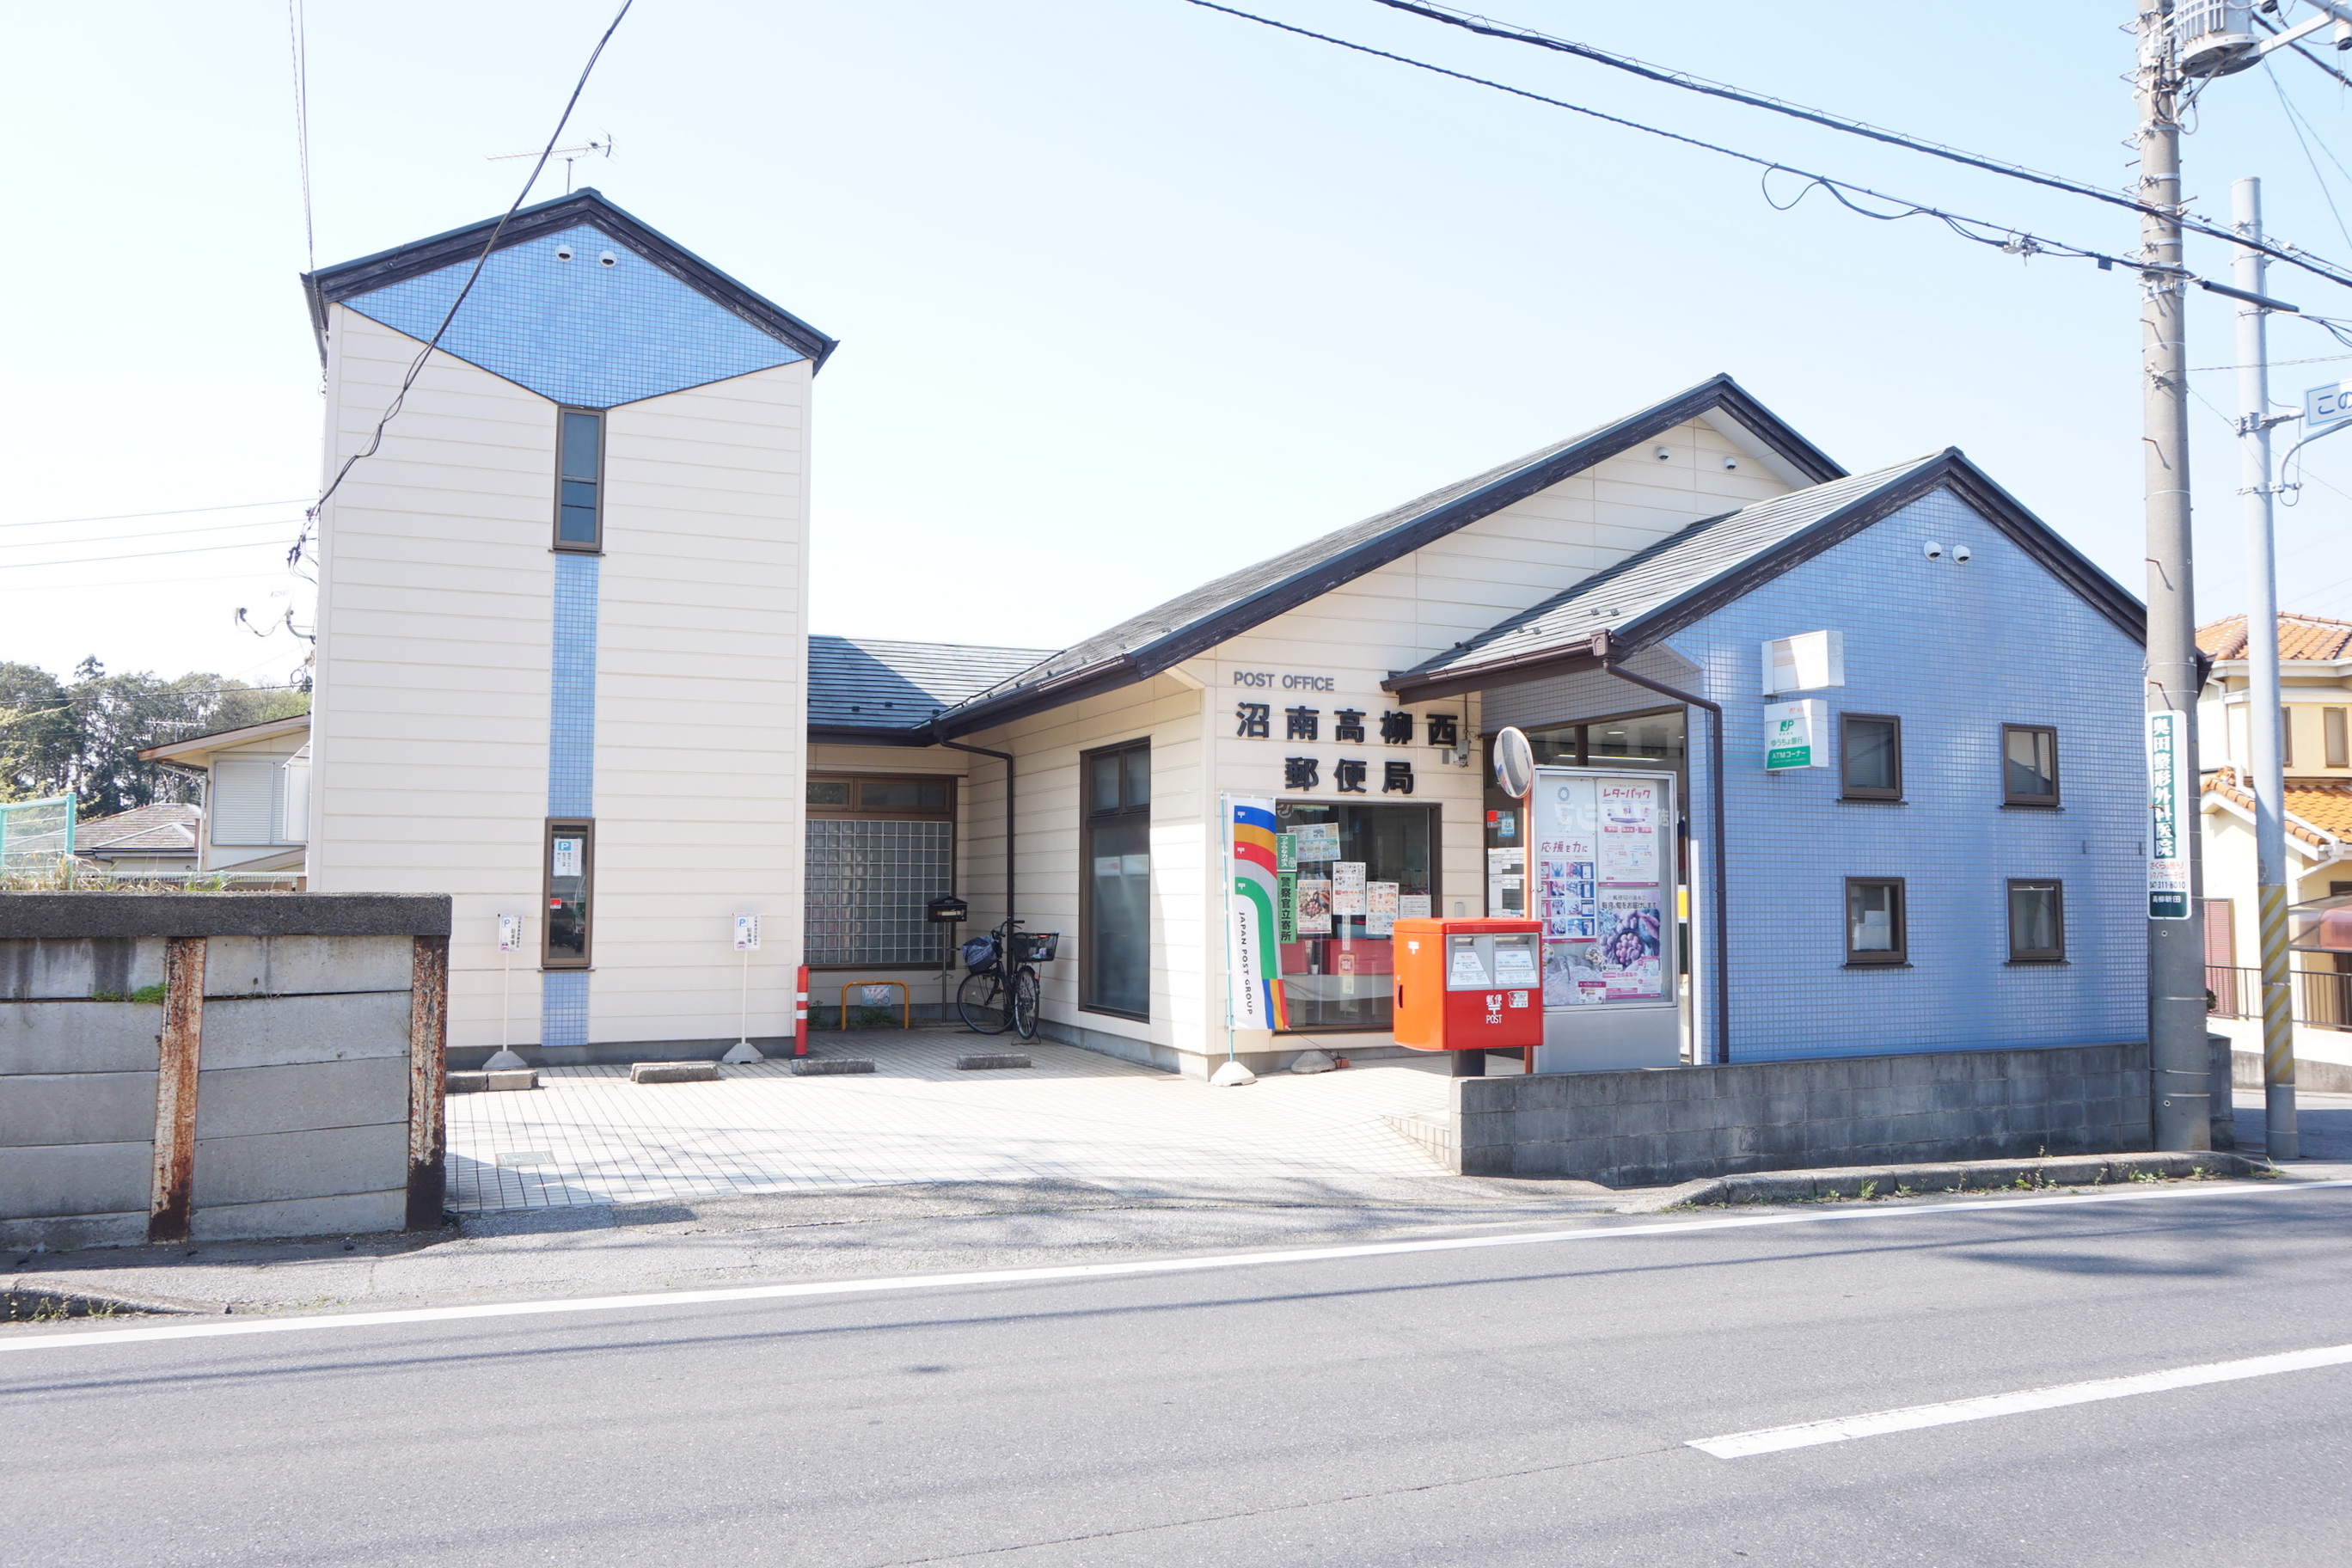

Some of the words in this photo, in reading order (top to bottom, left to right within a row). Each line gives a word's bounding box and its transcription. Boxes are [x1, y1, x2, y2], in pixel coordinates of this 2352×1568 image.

[1234, 671, 1275, 688] POST
[1282, 674, 1335, 691] OFFICE
[1235, 701, 1459, 746] 沼南高柳西
[1770, 736, 1803, 747] ゆうちょ銀行
[1772, 750, 1807, 759] ATMコーナー
[1284, 756, 1415, 794] 郵便局
[2153, 718, 2174, 857] 奥田整形外科医院
[1603, 788, 1651, 799] レターパック
[1280, 836, 1289, 867] つぶらなカボス
[1540, 841, 1589, 853] 応援を力に
[1281, 877, 1291, 941] 警察官立寄所
[1245, 979, 1253, 1015] GROUP
[1485, 1014, 1503, 1024] POST
